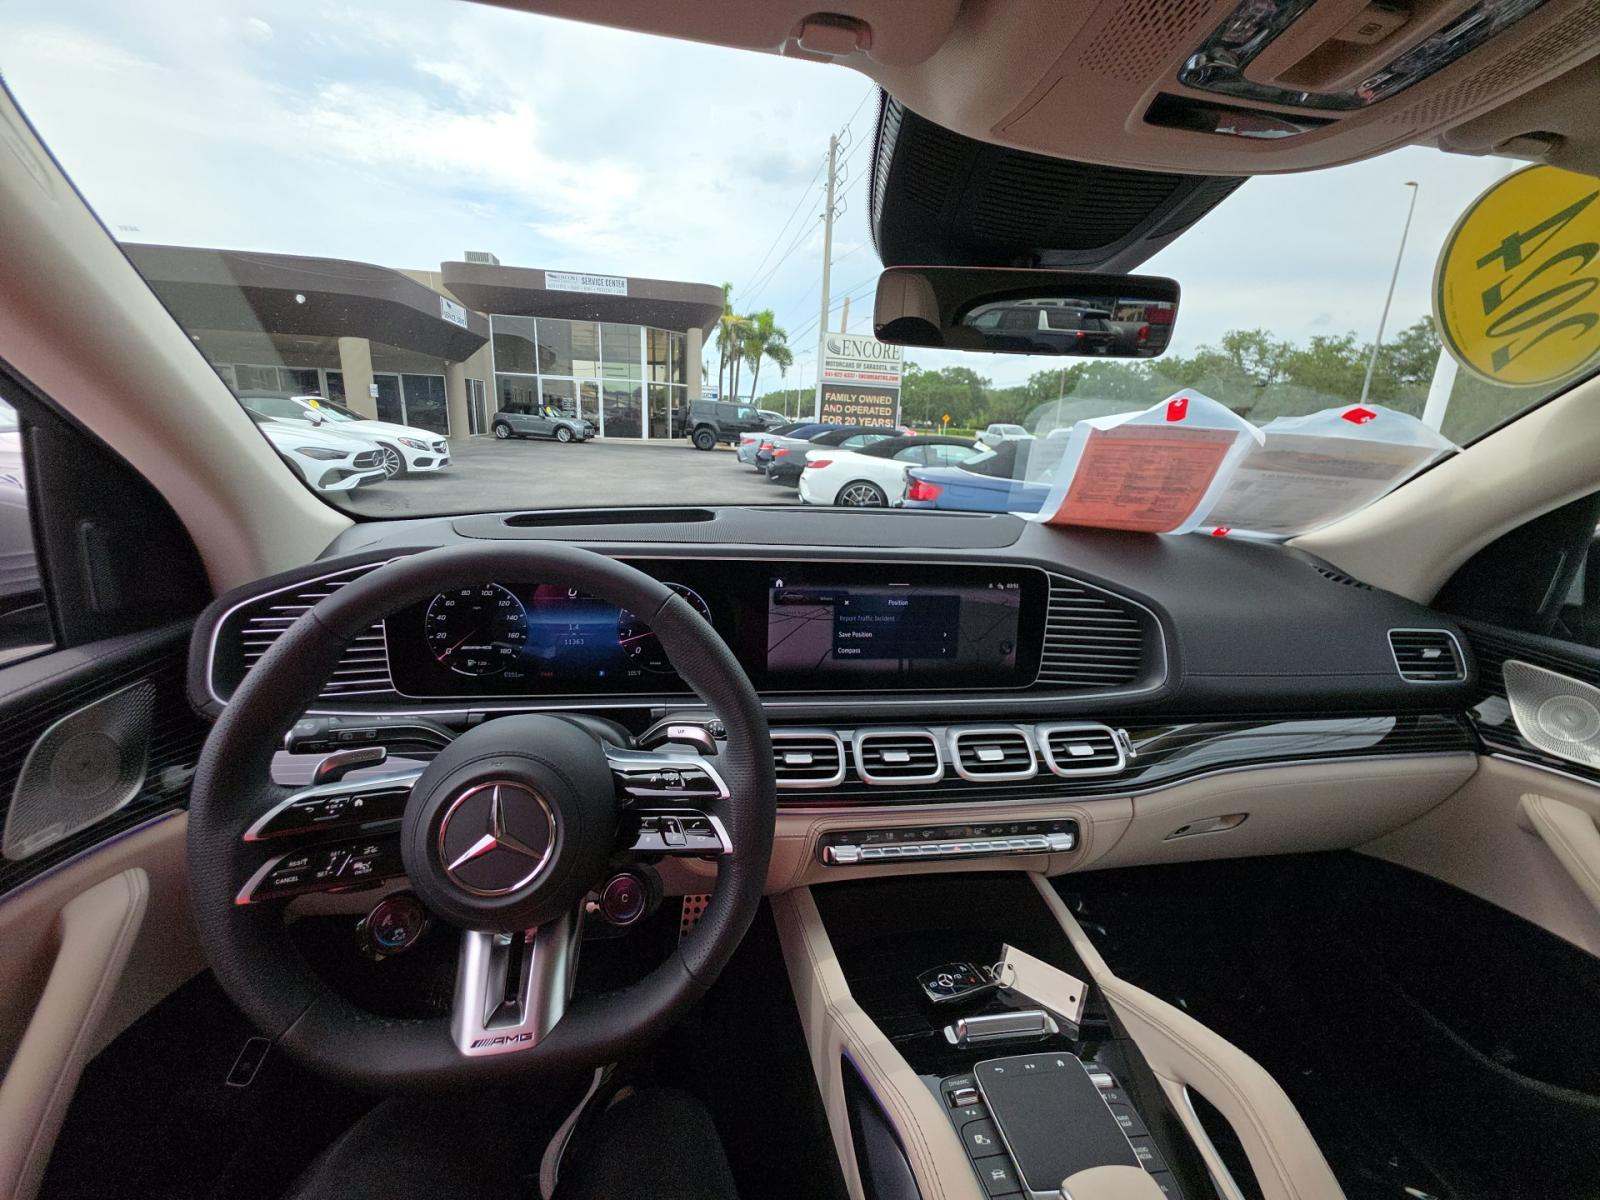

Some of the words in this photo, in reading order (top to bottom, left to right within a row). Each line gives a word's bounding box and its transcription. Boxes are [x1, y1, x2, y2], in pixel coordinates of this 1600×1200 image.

[581, 276, 603, 287] SERVICE
[605, 278, 625, 289] CENTER
[842, 339, 900, 360] ENCORE
[825, 392, 857, 403] FAMILY
[858, 395, 892, 405] OWNED
[823, 403, 843, 414] AND
[843, 405, 892, 416] OPERATED
[821, 415, 843, 425] FOR
[844, 417, 857, 426] 20
[858, 417, 894, 429] YEARS!
[857, 614, 874, 622] Traffic
[875, 614, 895, 622] Incident
[851, 631, 873, 639] Position
[837, 647, 861, 655] Compass
[275, 875, 299, 885] CANCEL
